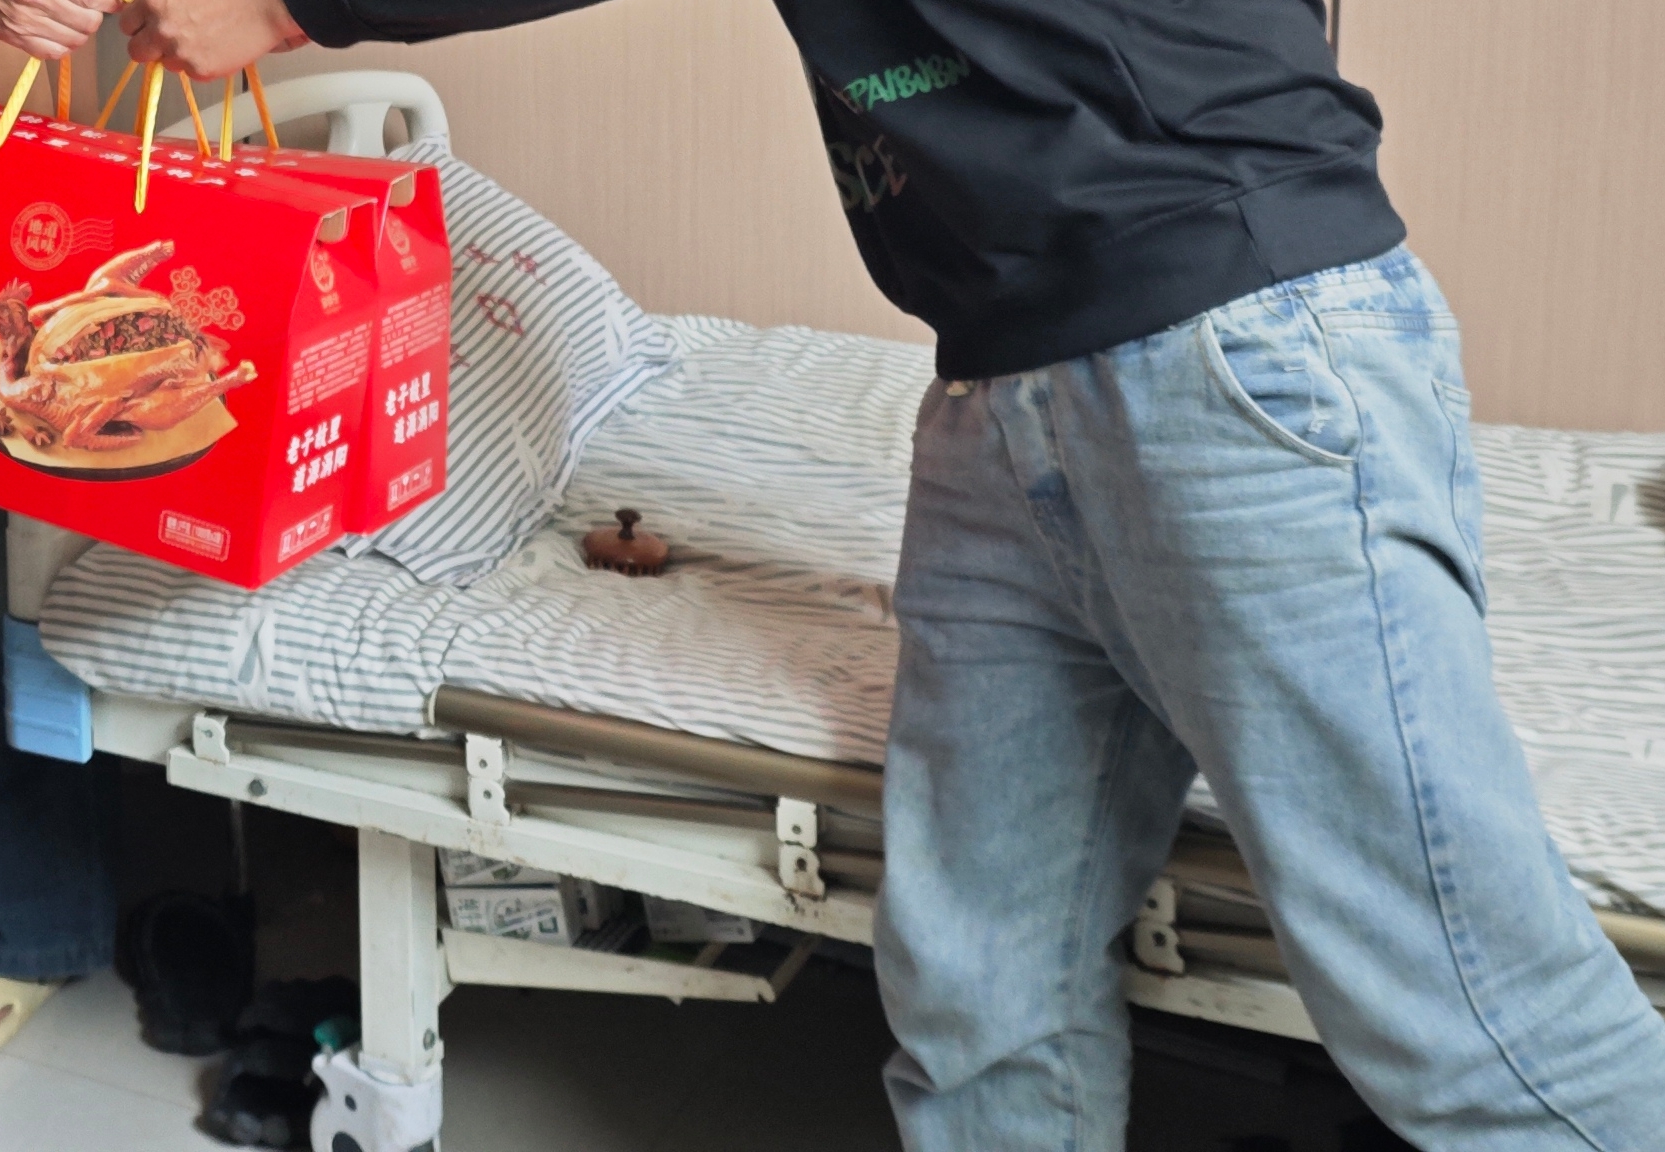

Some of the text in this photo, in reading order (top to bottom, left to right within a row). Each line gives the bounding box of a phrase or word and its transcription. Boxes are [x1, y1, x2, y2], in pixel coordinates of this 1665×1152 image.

[385, 371, 431, 417] 老子故里
[286, 414, 342, 465] 老子故里
[292, 443, 349, 493] 道源涡阳
